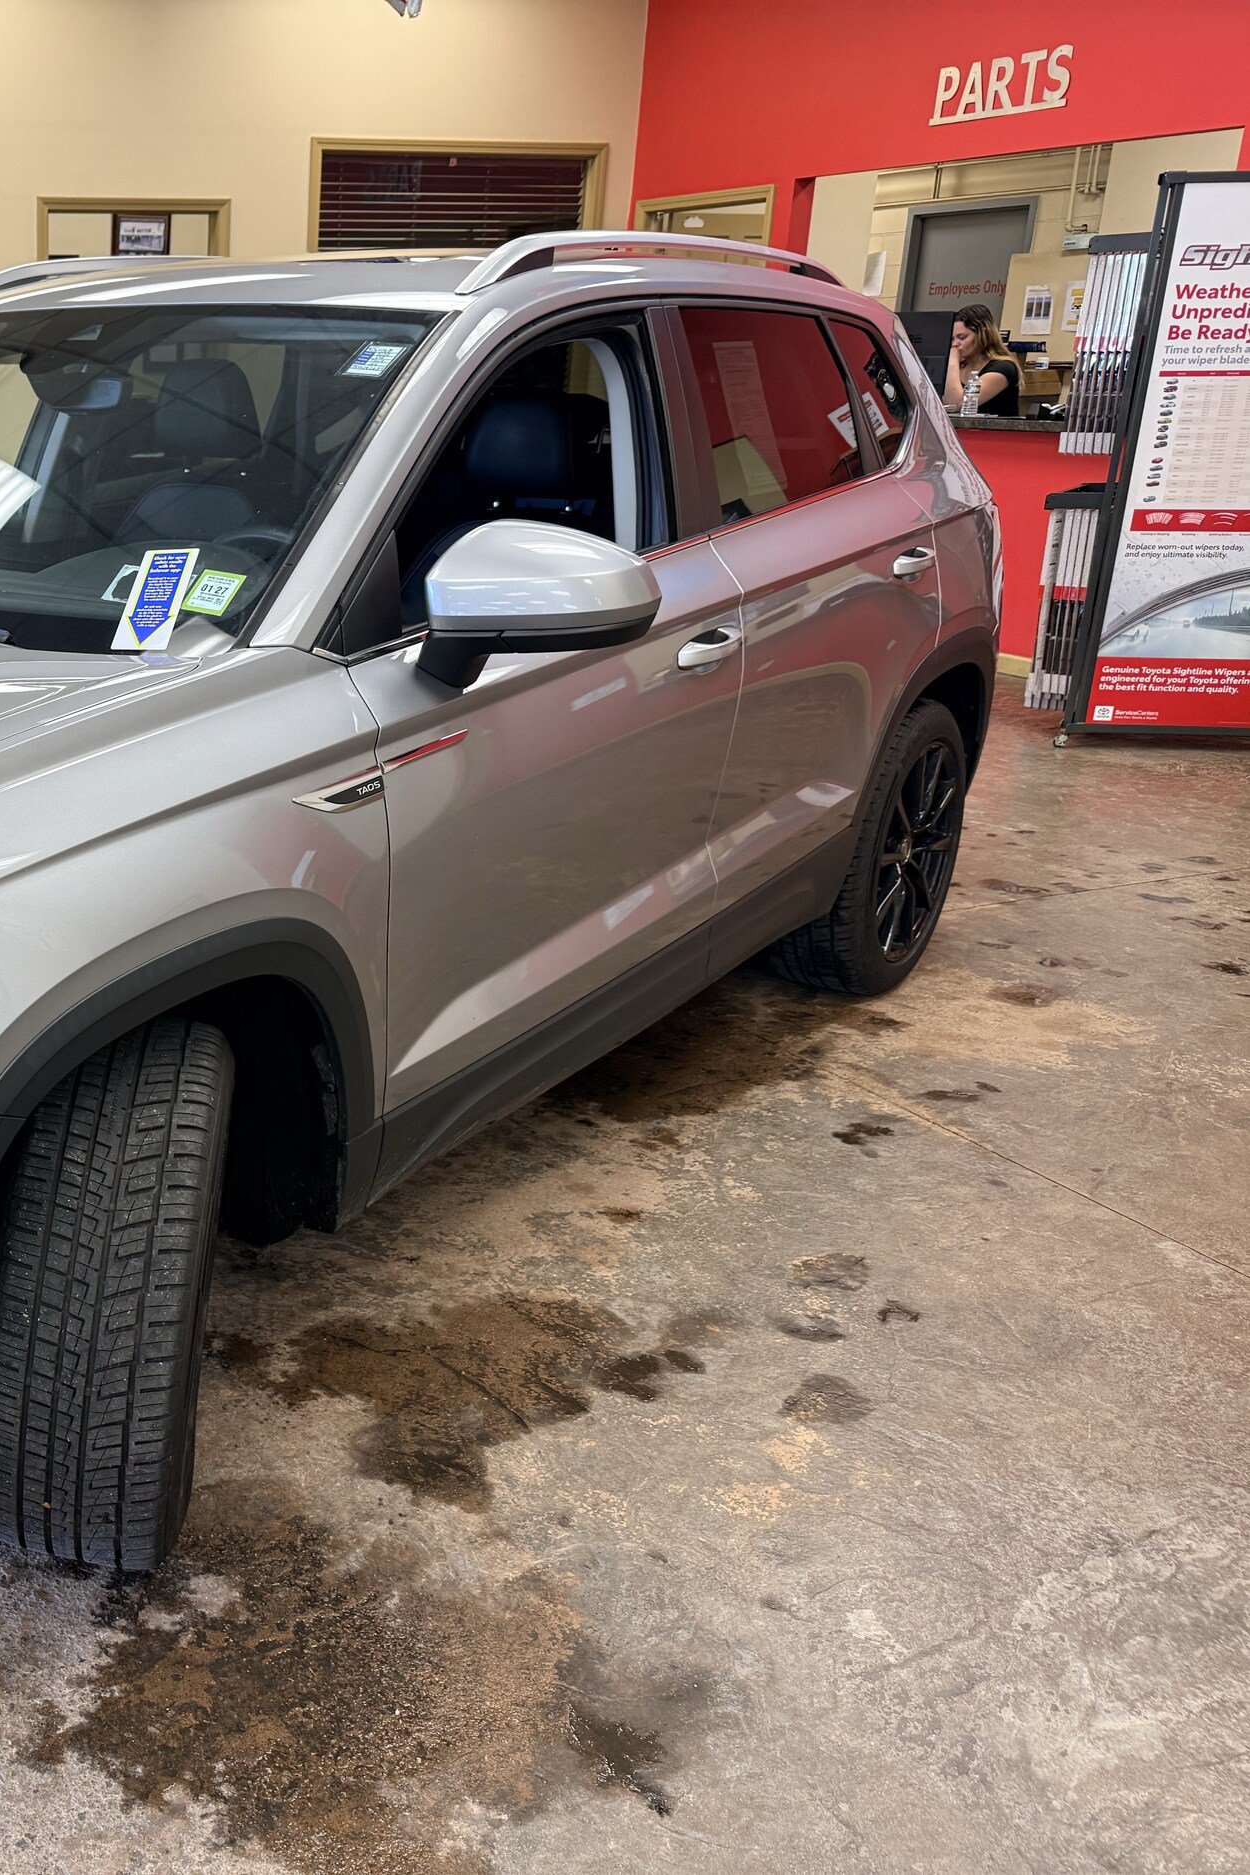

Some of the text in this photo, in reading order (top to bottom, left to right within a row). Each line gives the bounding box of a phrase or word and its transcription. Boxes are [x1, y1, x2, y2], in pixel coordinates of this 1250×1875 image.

[930, 44, 1074, 122] PARTS
[928, 281, 981, 298] Employees
[983, 279, 1007, 297] Only
[1175, 282, 1250, 300] Weathe
[1167, 324, 1192, 341] Be
[1164, 345, 1190, 354] Time
[1192, 345, 1203, 354] to
[1205, 344, 1243, 354] refresh
[1161, 357, 1186, 367] your
[1188, 355, 1218, 366] wiper
[1126, 543, 1157, 551] Replace
[1195, 543, 1220, 551] wipers
[1222, 543, 1245, 552] today,
[1102, 665, 1140, 674] Genuine
[1141, 666, 1172, 675] Toyota
[1173, 667, 1213, 676] Sightline
[1214, 667, 1246, 677] Wipers
[1100, 675, 1151, 684] engineered
[1166, 677, 1187, 685] your
[1188, 676, 1218, 685] Toyota
[1115, 683, 1135, 691] best
[1136, 683, 1147, 691] fit
[1148, 684, 1187, 692] function
[1187, 685, 1204, 693] and
[1206, 686, 1239, 695] quality.
[356, 780, 381, 796] TAOS
